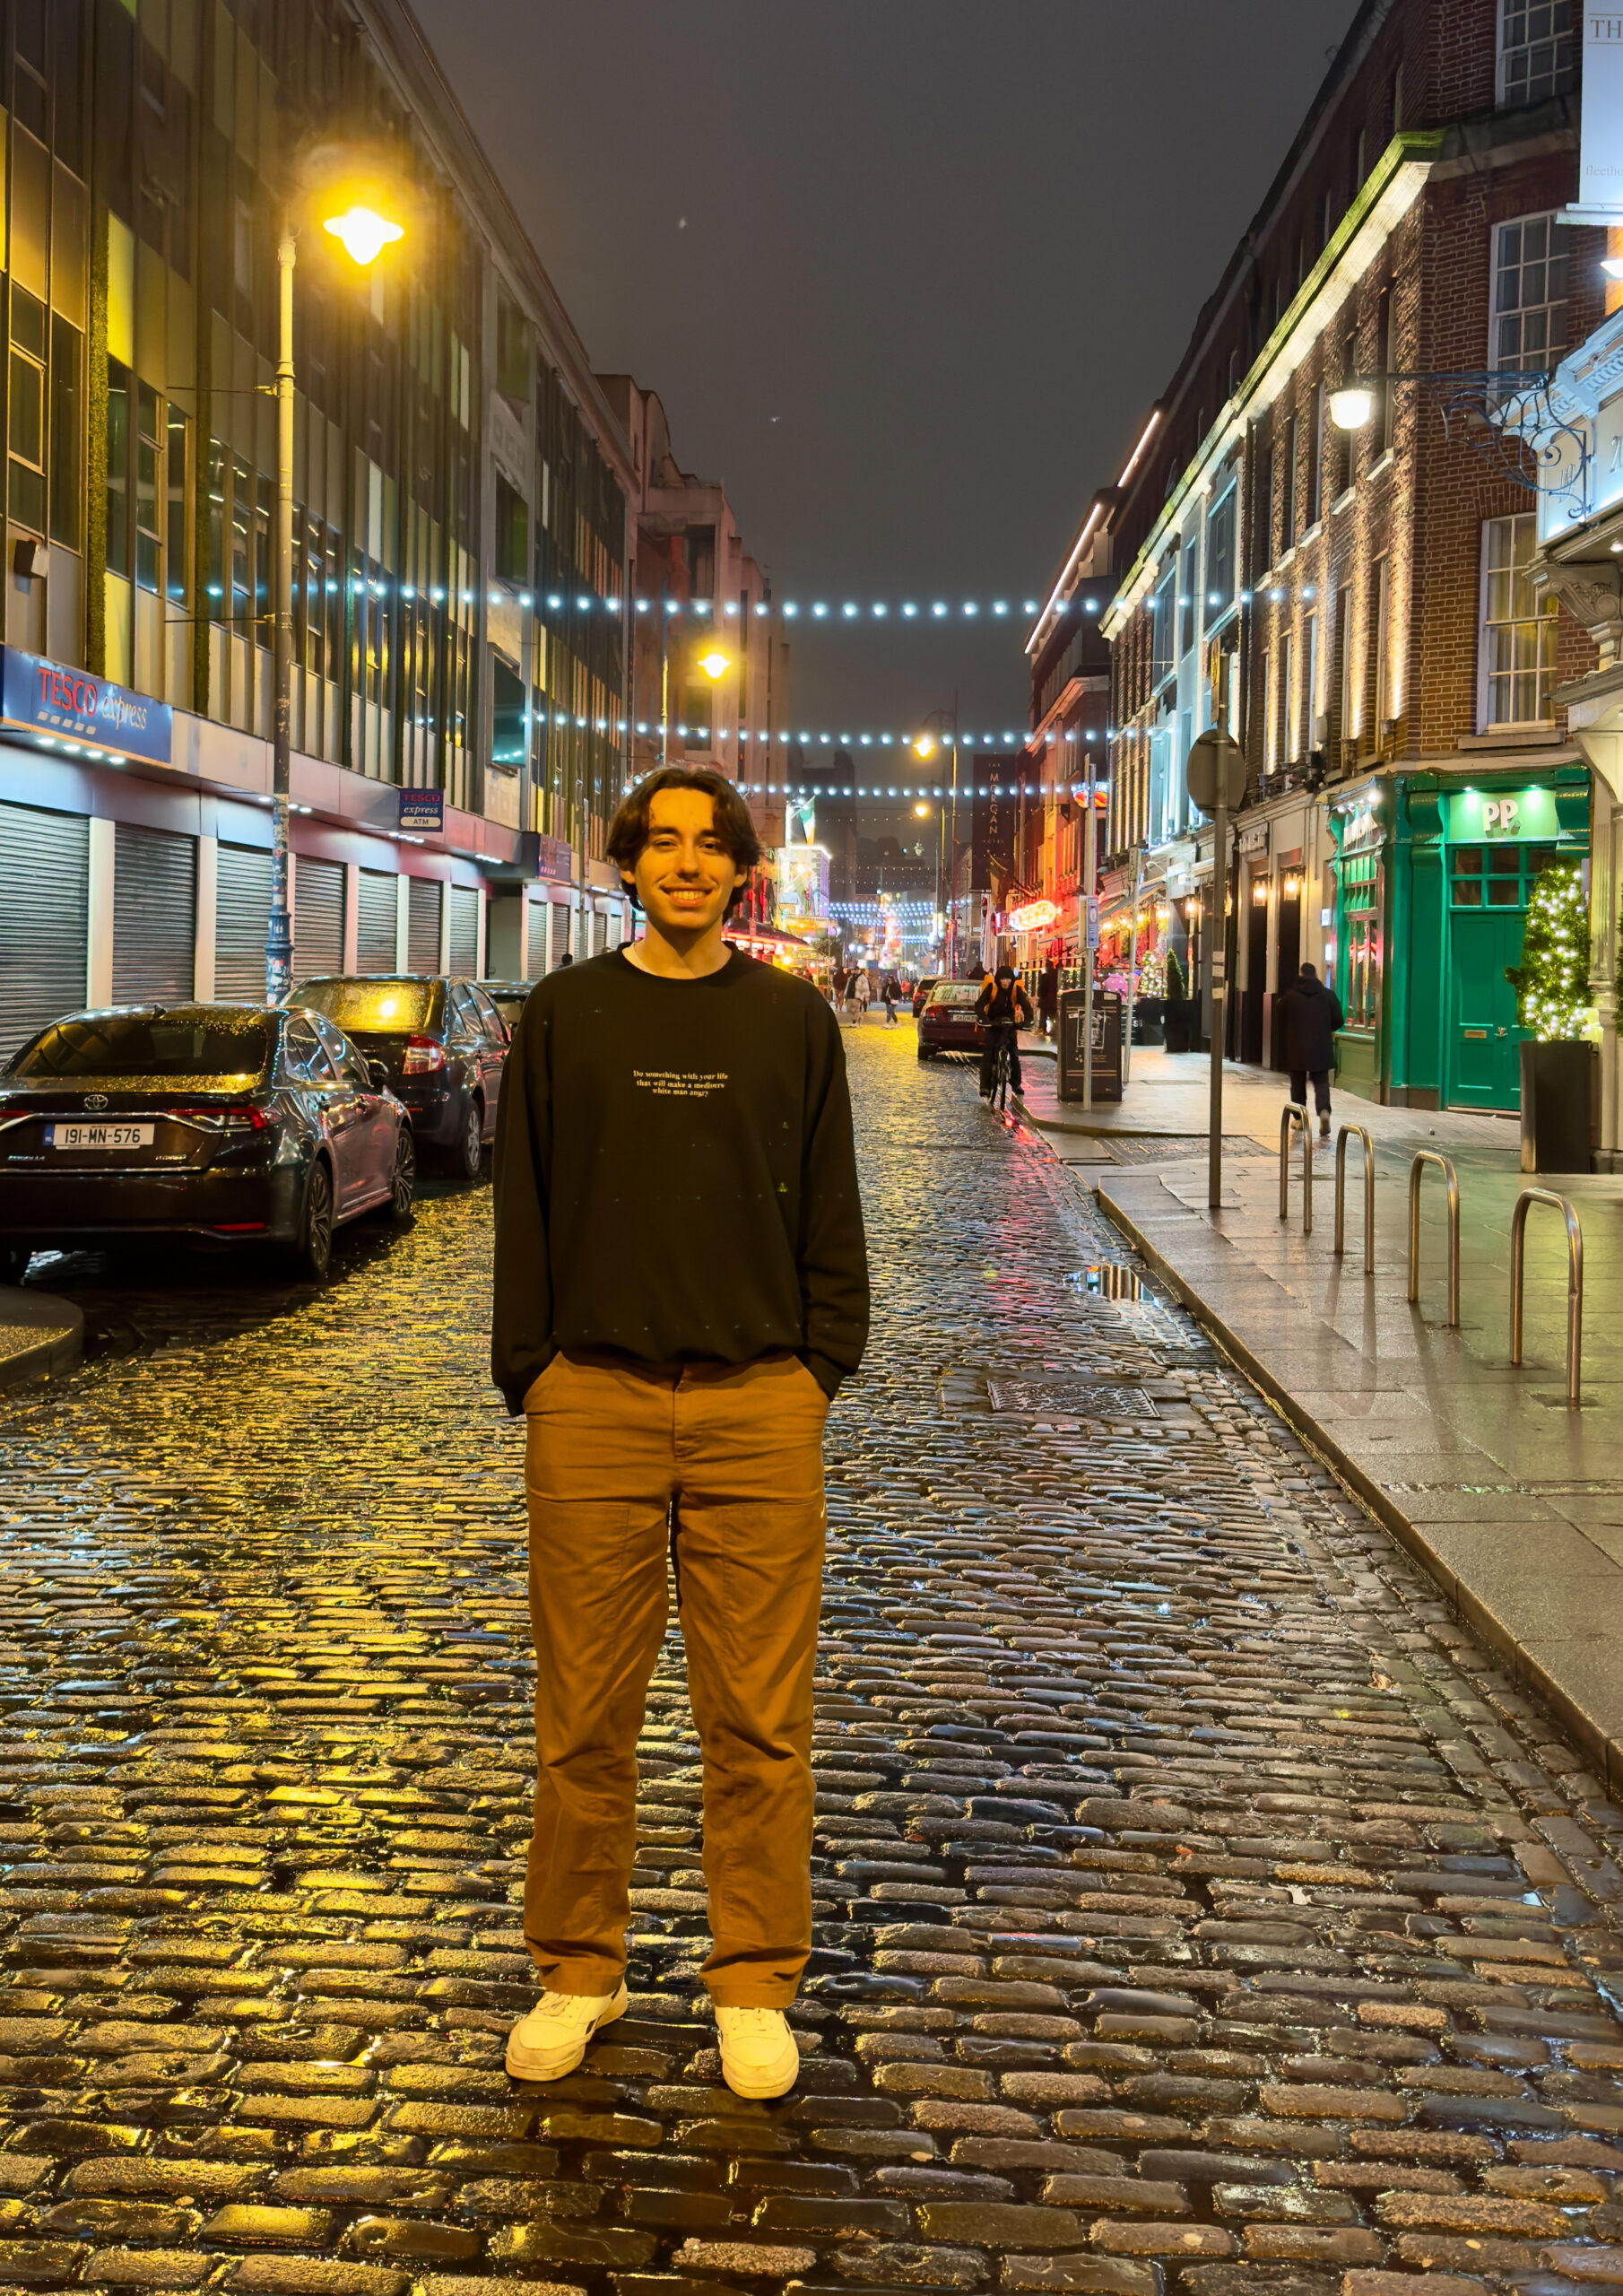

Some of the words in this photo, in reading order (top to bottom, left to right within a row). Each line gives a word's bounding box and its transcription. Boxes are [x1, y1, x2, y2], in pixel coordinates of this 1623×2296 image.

[38, 667, 98, 718] TESCO
[101, 695, 148, 731] express
[403, 794, 440, 802] TESCO
[990, 773, 999, 834] MORGAN
[404, 806, 438, 815] express
[645, 1072, 680, 1080] something
[681, 1072, 699, 1080] with
[716, 1072, 729, 1080] life
[65, 1128, 141, 1144] 191-MN-576
